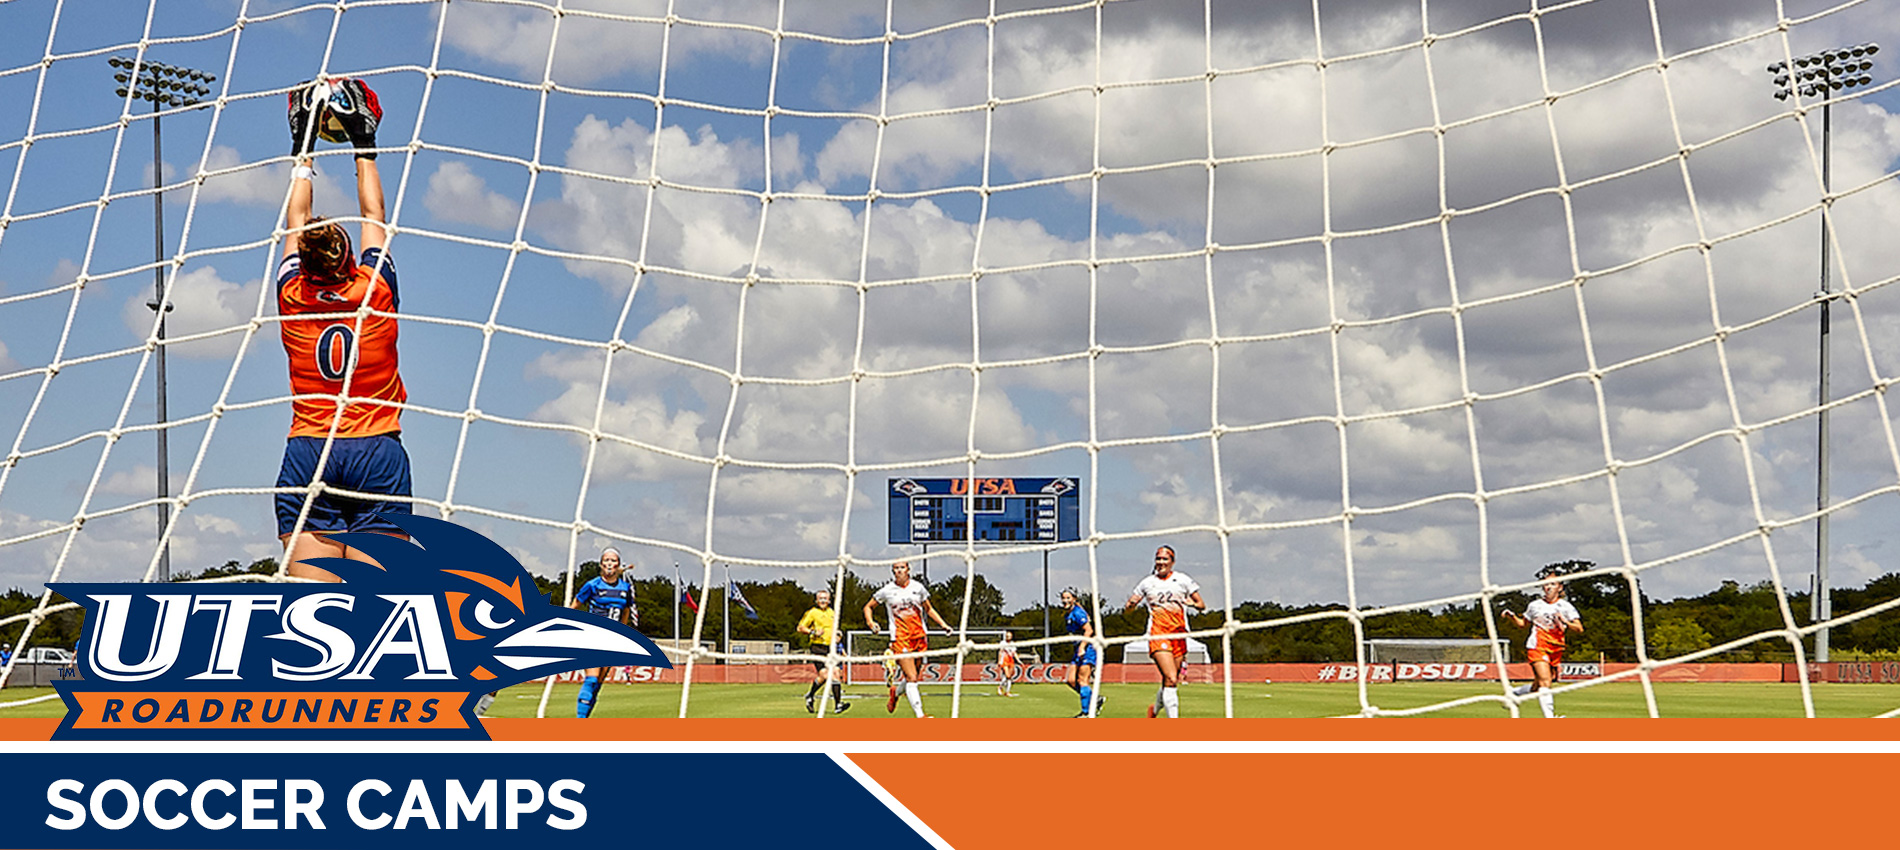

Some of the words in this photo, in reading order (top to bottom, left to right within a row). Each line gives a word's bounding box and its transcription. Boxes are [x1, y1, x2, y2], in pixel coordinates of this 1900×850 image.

[316, 324, 357, 381] 0
[950, 478, 1016, 495] UTSA
[1157, 591, 1174, 604] 22
[607, 606, 621, 621] 12
[1318, 663, 1487, 681] #BIRDSUP
[1562, 663, 1600, 676] UTSA
